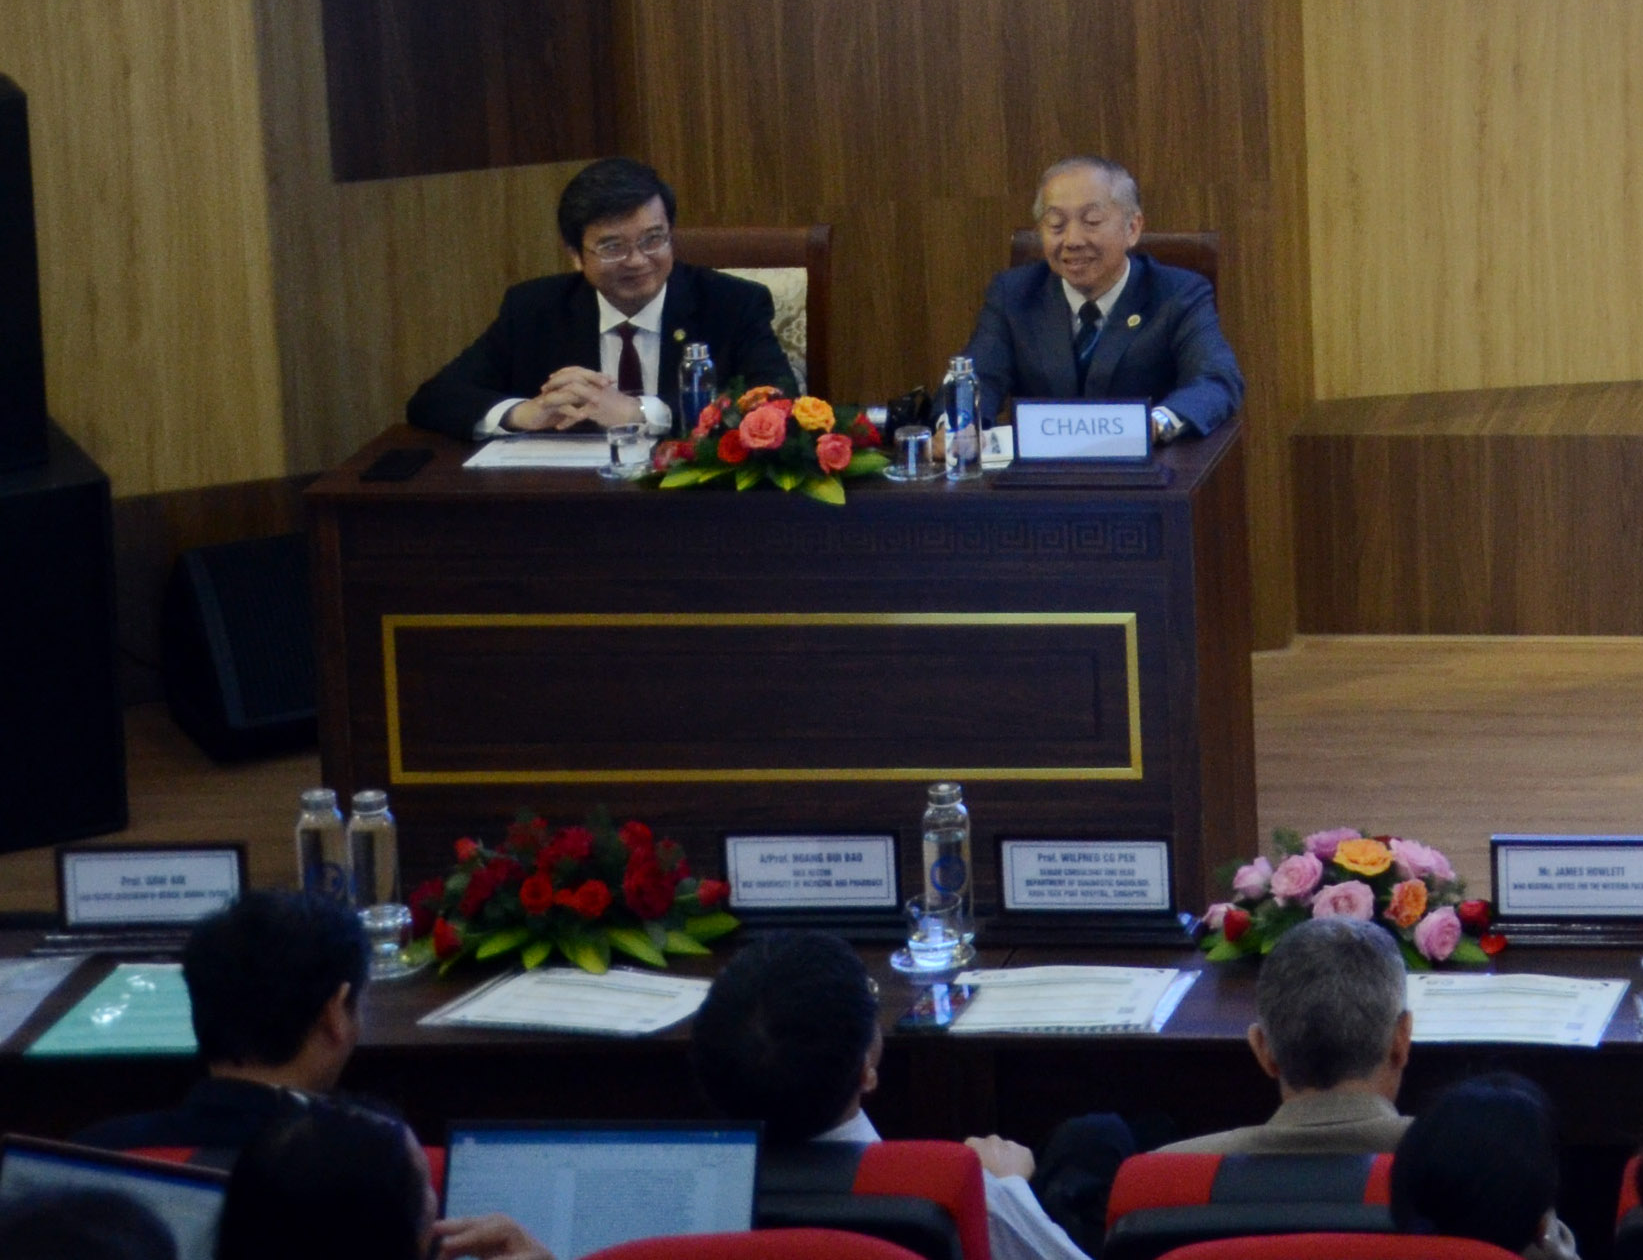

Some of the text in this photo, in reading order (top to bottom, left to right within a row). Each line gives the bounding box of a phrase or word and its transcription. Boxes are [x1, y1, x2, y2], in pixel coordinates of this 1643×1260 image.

[1041, 417, 1124, 436] CHAIRS
[1555, 867, 1584, 877] JAMES
[1587, 867, 1625, 877] HOWLETT
